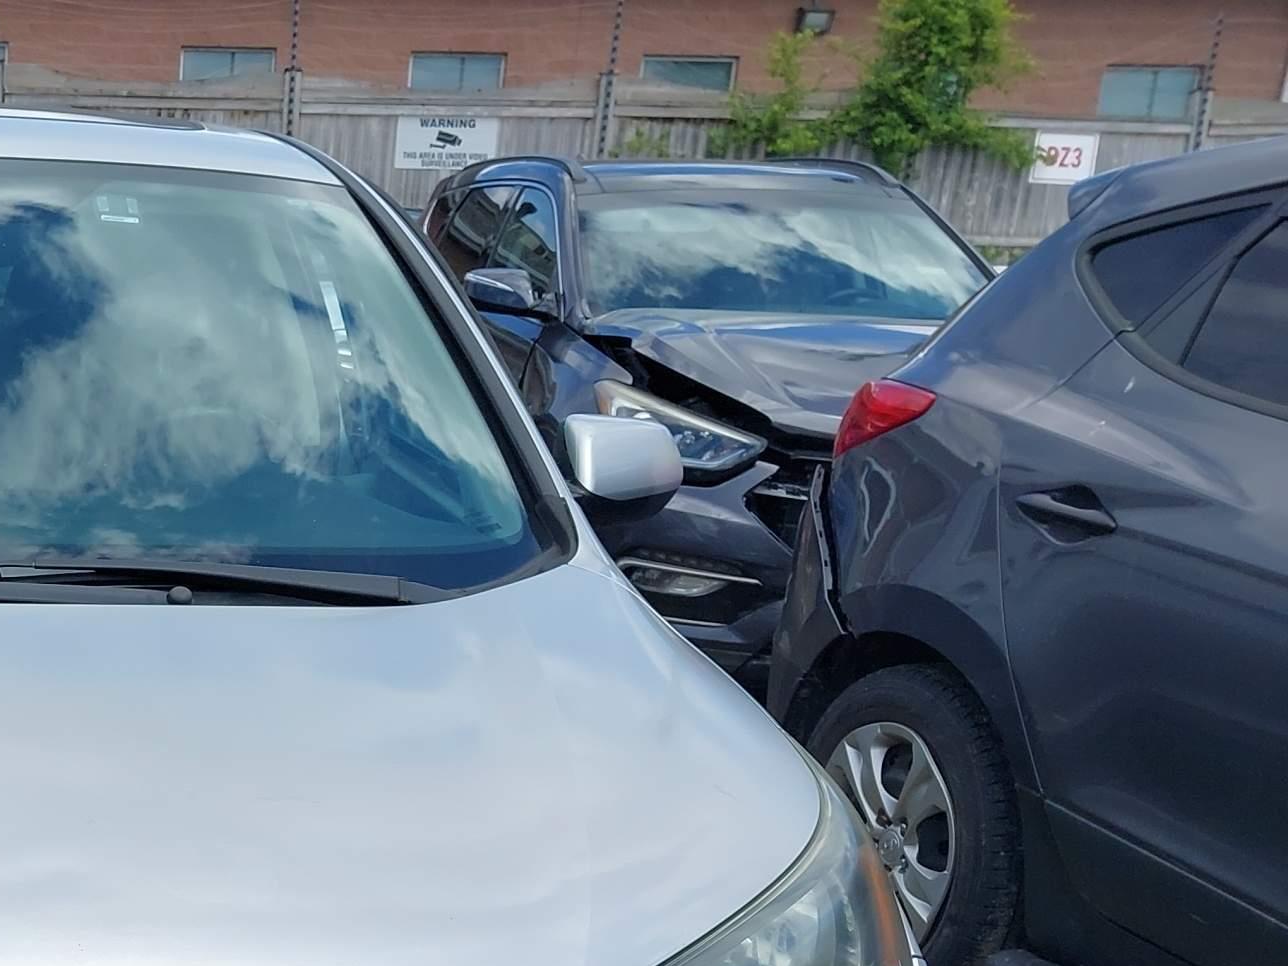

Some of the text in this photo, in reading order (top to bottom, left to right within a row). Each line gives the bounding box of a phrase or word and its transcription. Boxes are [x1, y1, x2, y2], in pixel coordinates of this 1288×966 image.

[419, 118, 476, 128] WARNING
[419, 151, 435, 160] AREA
[445, 152, 467, 160] UNDER
